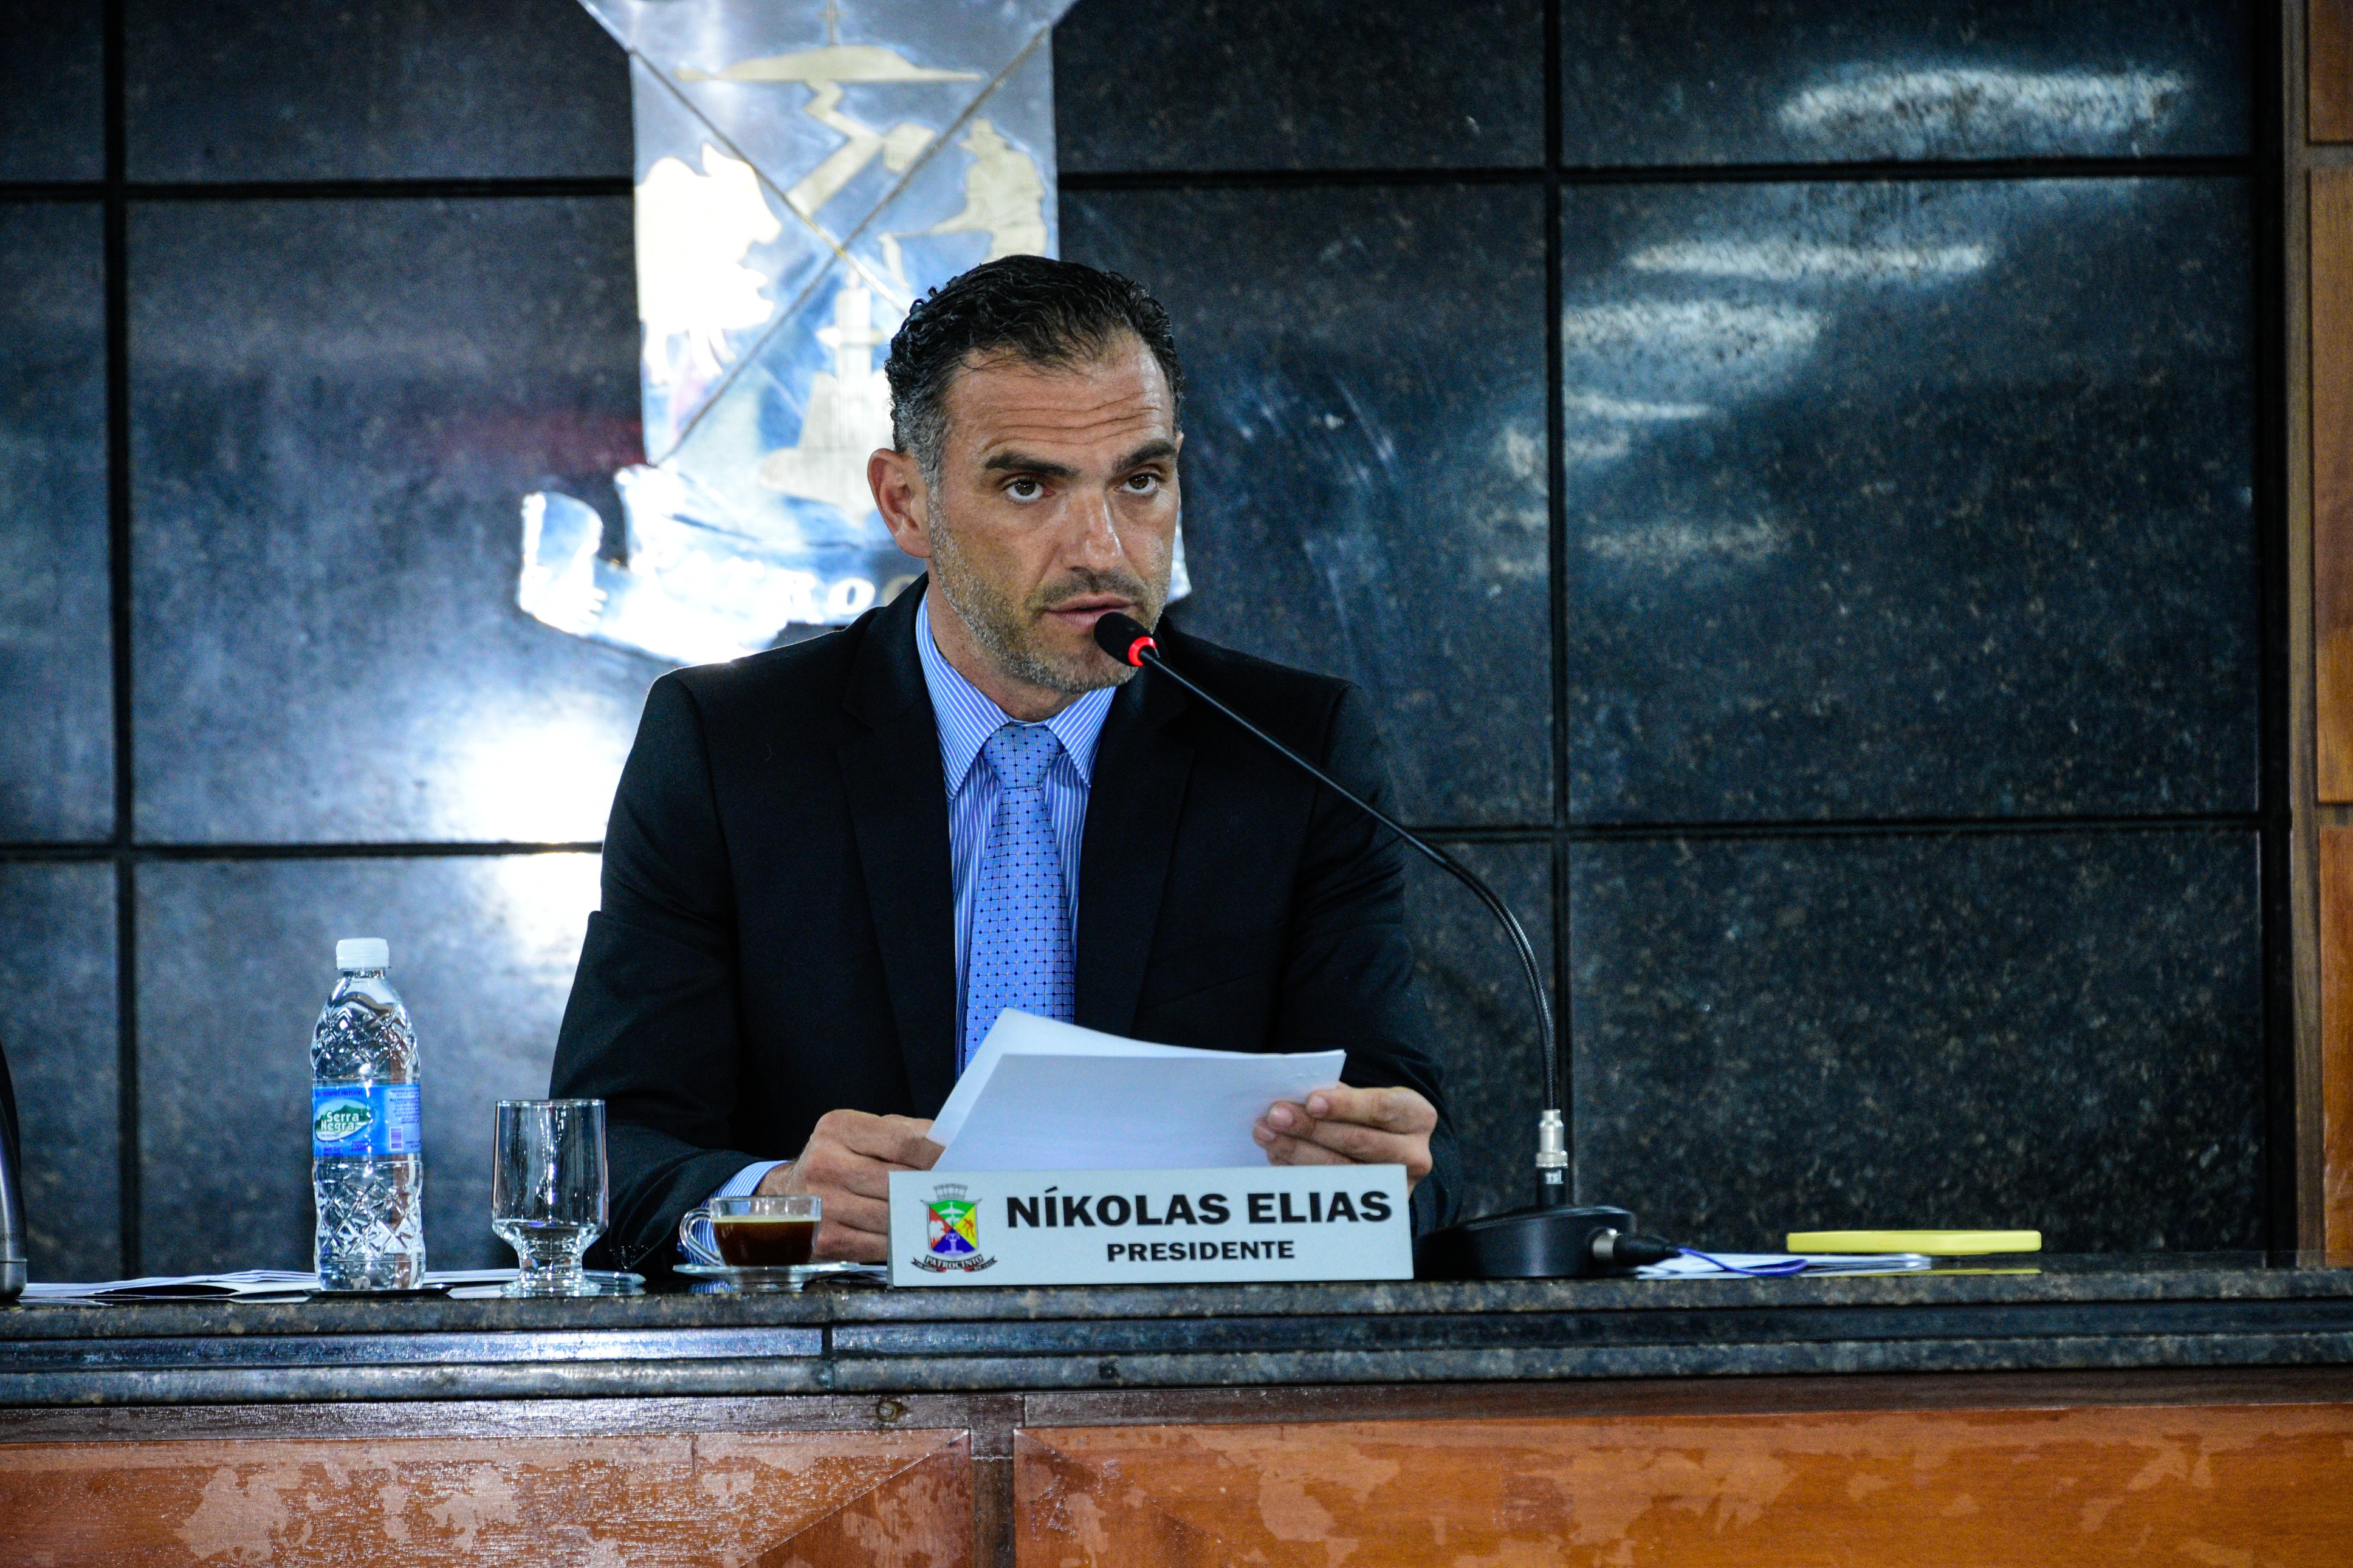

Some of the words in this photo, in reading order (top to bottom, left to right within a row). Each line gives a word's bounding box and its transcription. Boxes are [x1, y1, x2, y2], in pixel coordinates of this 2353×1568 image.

[326, 1111, 359, 1122] Serra
[321, 1120, 354, 1134] Negra
[1007, 1186, 1230, 1228] NÍKOLAS
[1248, 1191, 1392, 1224] ELIAS
[1107, 1240, 1295, 1262] PRESIDENTE
